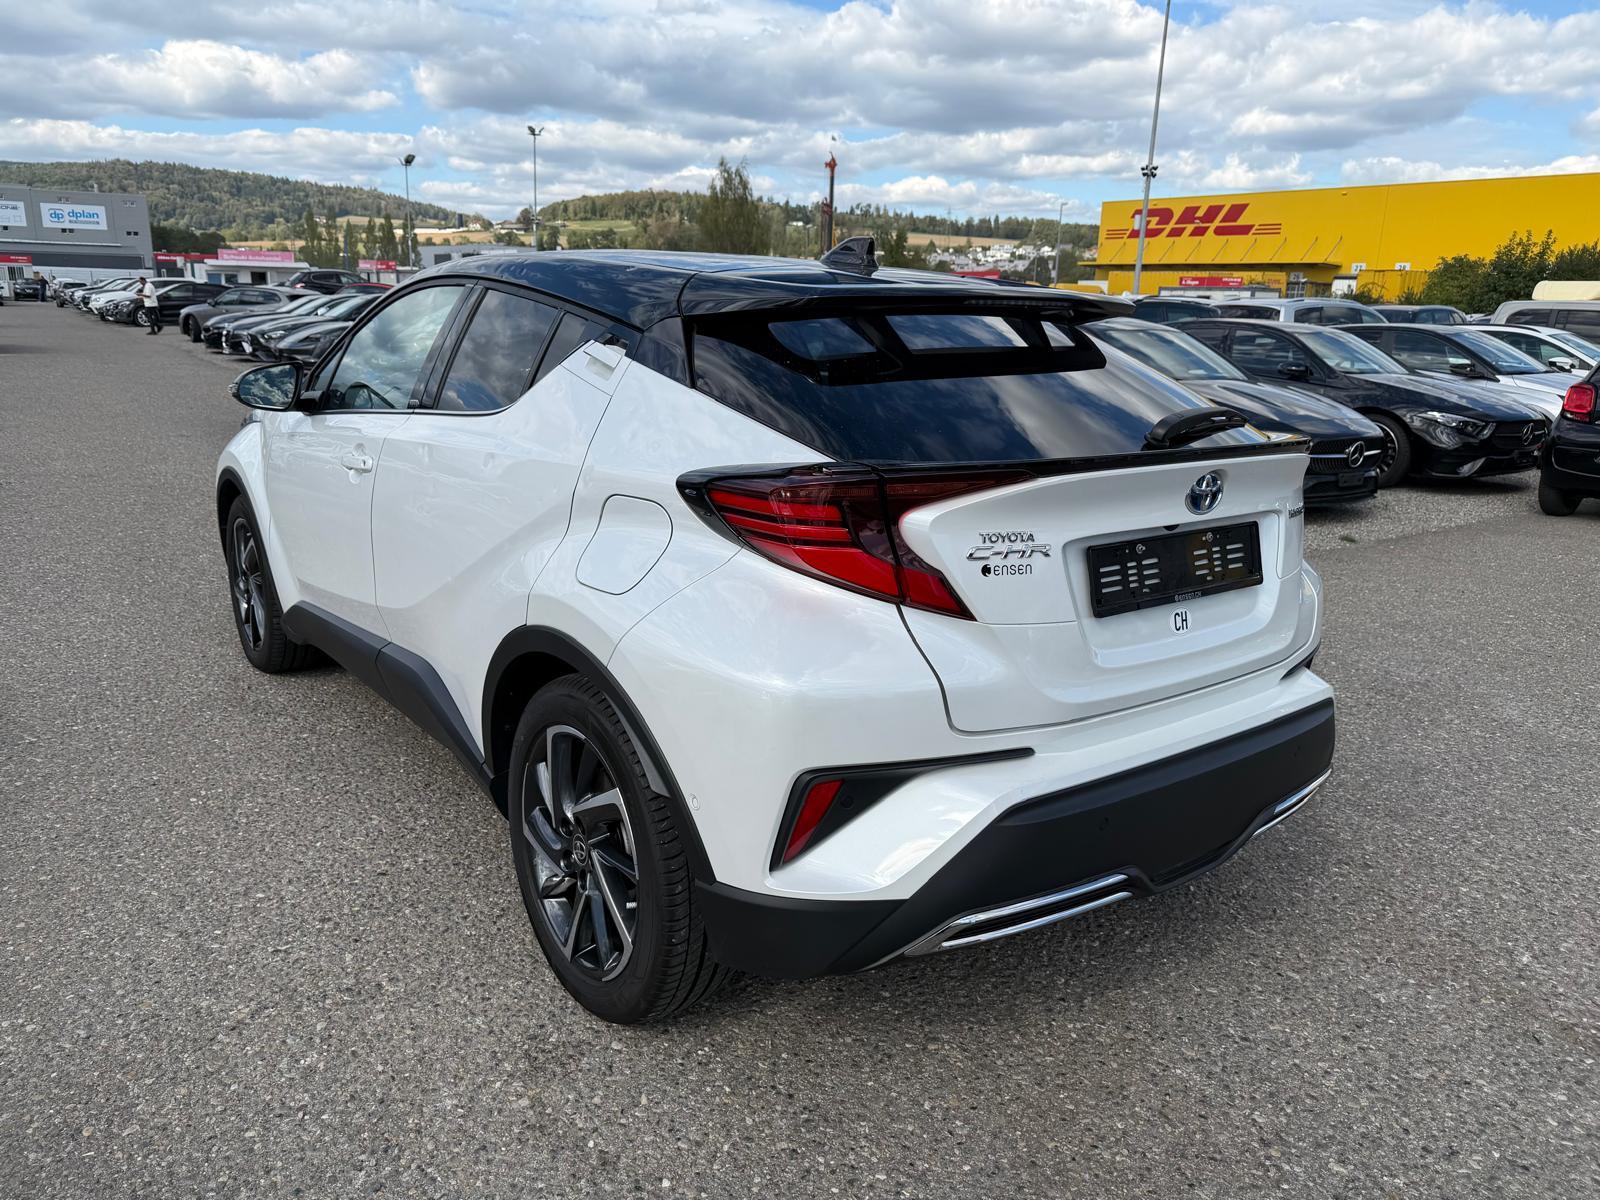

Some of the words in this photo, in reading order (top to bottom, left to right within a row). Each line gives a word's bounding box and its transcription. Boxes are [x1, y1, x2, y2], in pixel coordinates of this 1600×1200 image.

[67, 209, 99, 220] dplan
[1126, 203, 1256, 239] DHL
[979, 531, 1035, 544] TOYOTA
[966, 544, 1051, 561] C-HR
[1173, 610, 1189, 632] CH
